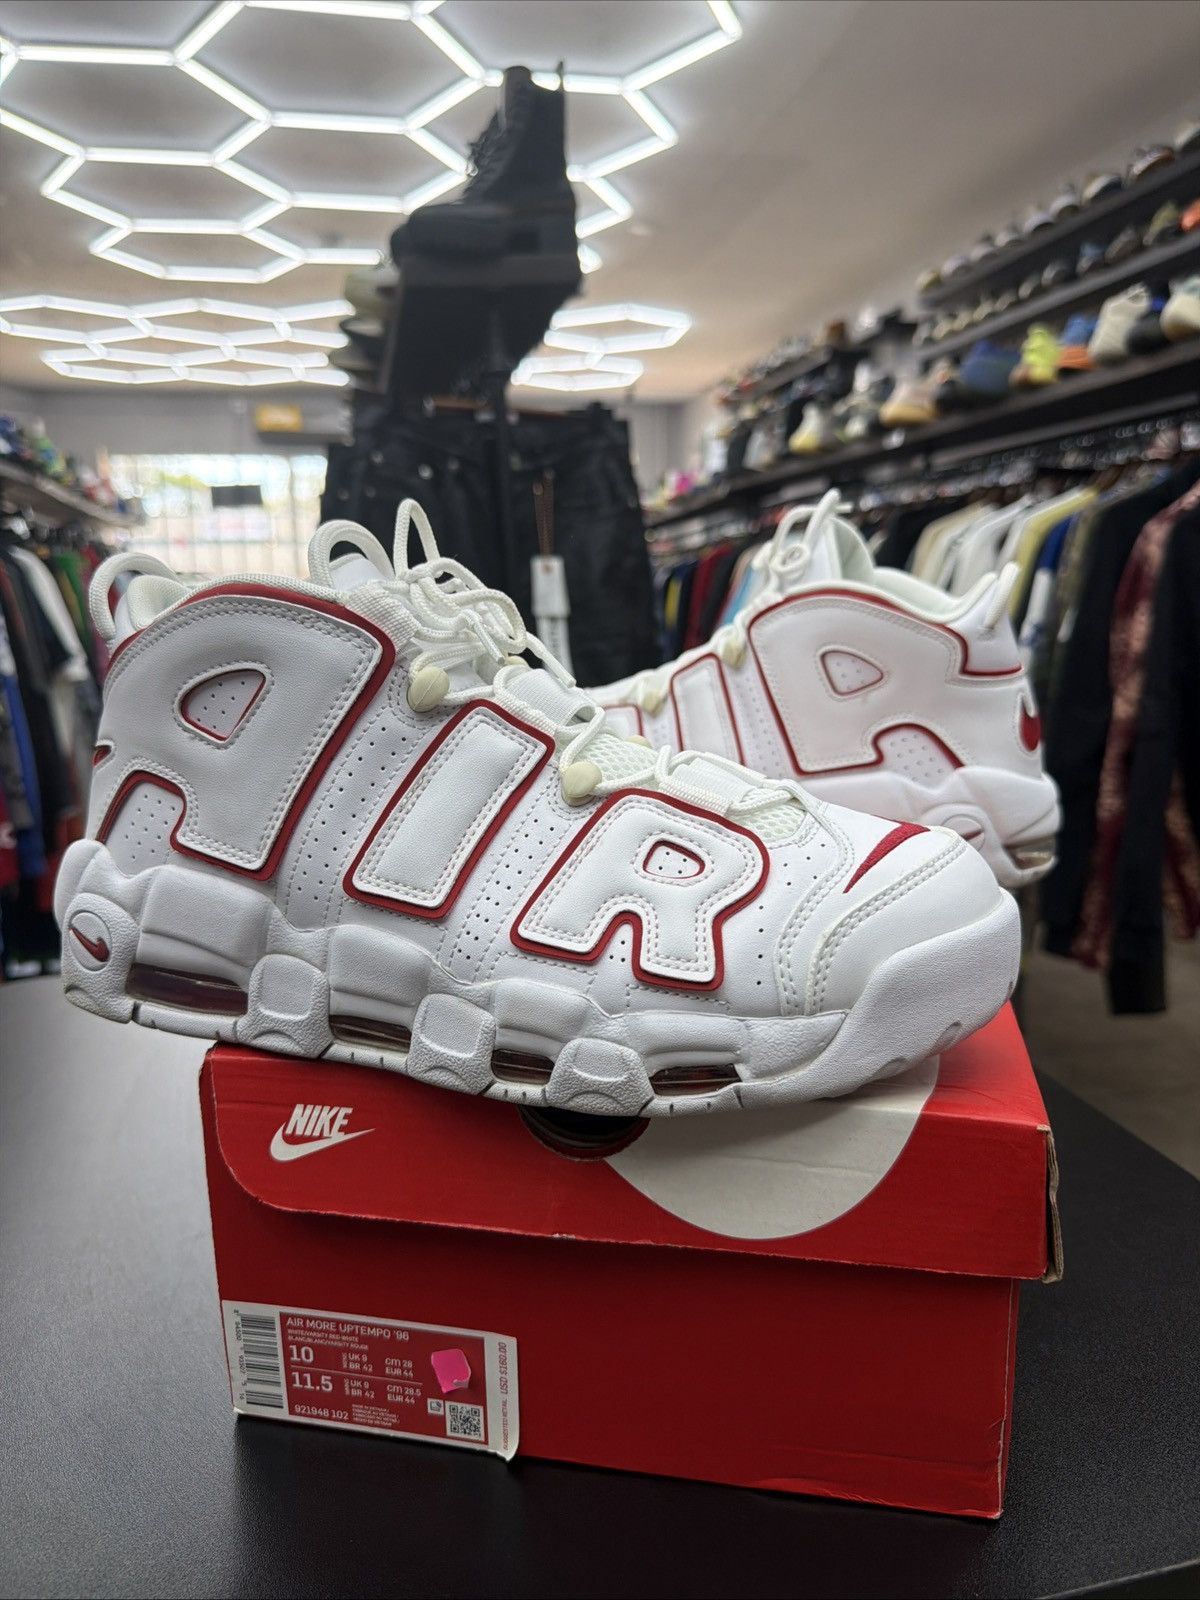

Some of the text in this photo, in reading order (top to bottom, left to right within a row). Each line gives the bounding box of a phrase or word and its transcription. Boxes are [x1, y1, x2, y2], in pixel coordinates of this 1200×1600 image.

[285, 1103, 353, 1138] NIKE
[286, 1317, 304, 1328] AIR
[306, 1319, 337, 1332] MORE
[339, 1323, 391, 1339] UPTEMPO
[289, 1344, 314, 1363] 10
[348, 1352, 360, 1361] UK
[499, 1342, 508, 1376] $160.00
[349, 1361, 373, 1373] BR 42
[402, 1360, 413, 1369] 28
[385, 1366, 414, 1379] EUR 44
[291, 1371, 333, 1393] 11.5
[350, 1379, 362, 1388] UK
[500, 1376, 508, 1395] USD
[351, 1388, 376, 1399] BR 42
[404, 1387, 422, 1397] 28.5
[387, 1393, 416, 1405] EUR 44
[294, 1404, 330, 1418] 921948
[332, 1410, 349, 1421] 102
